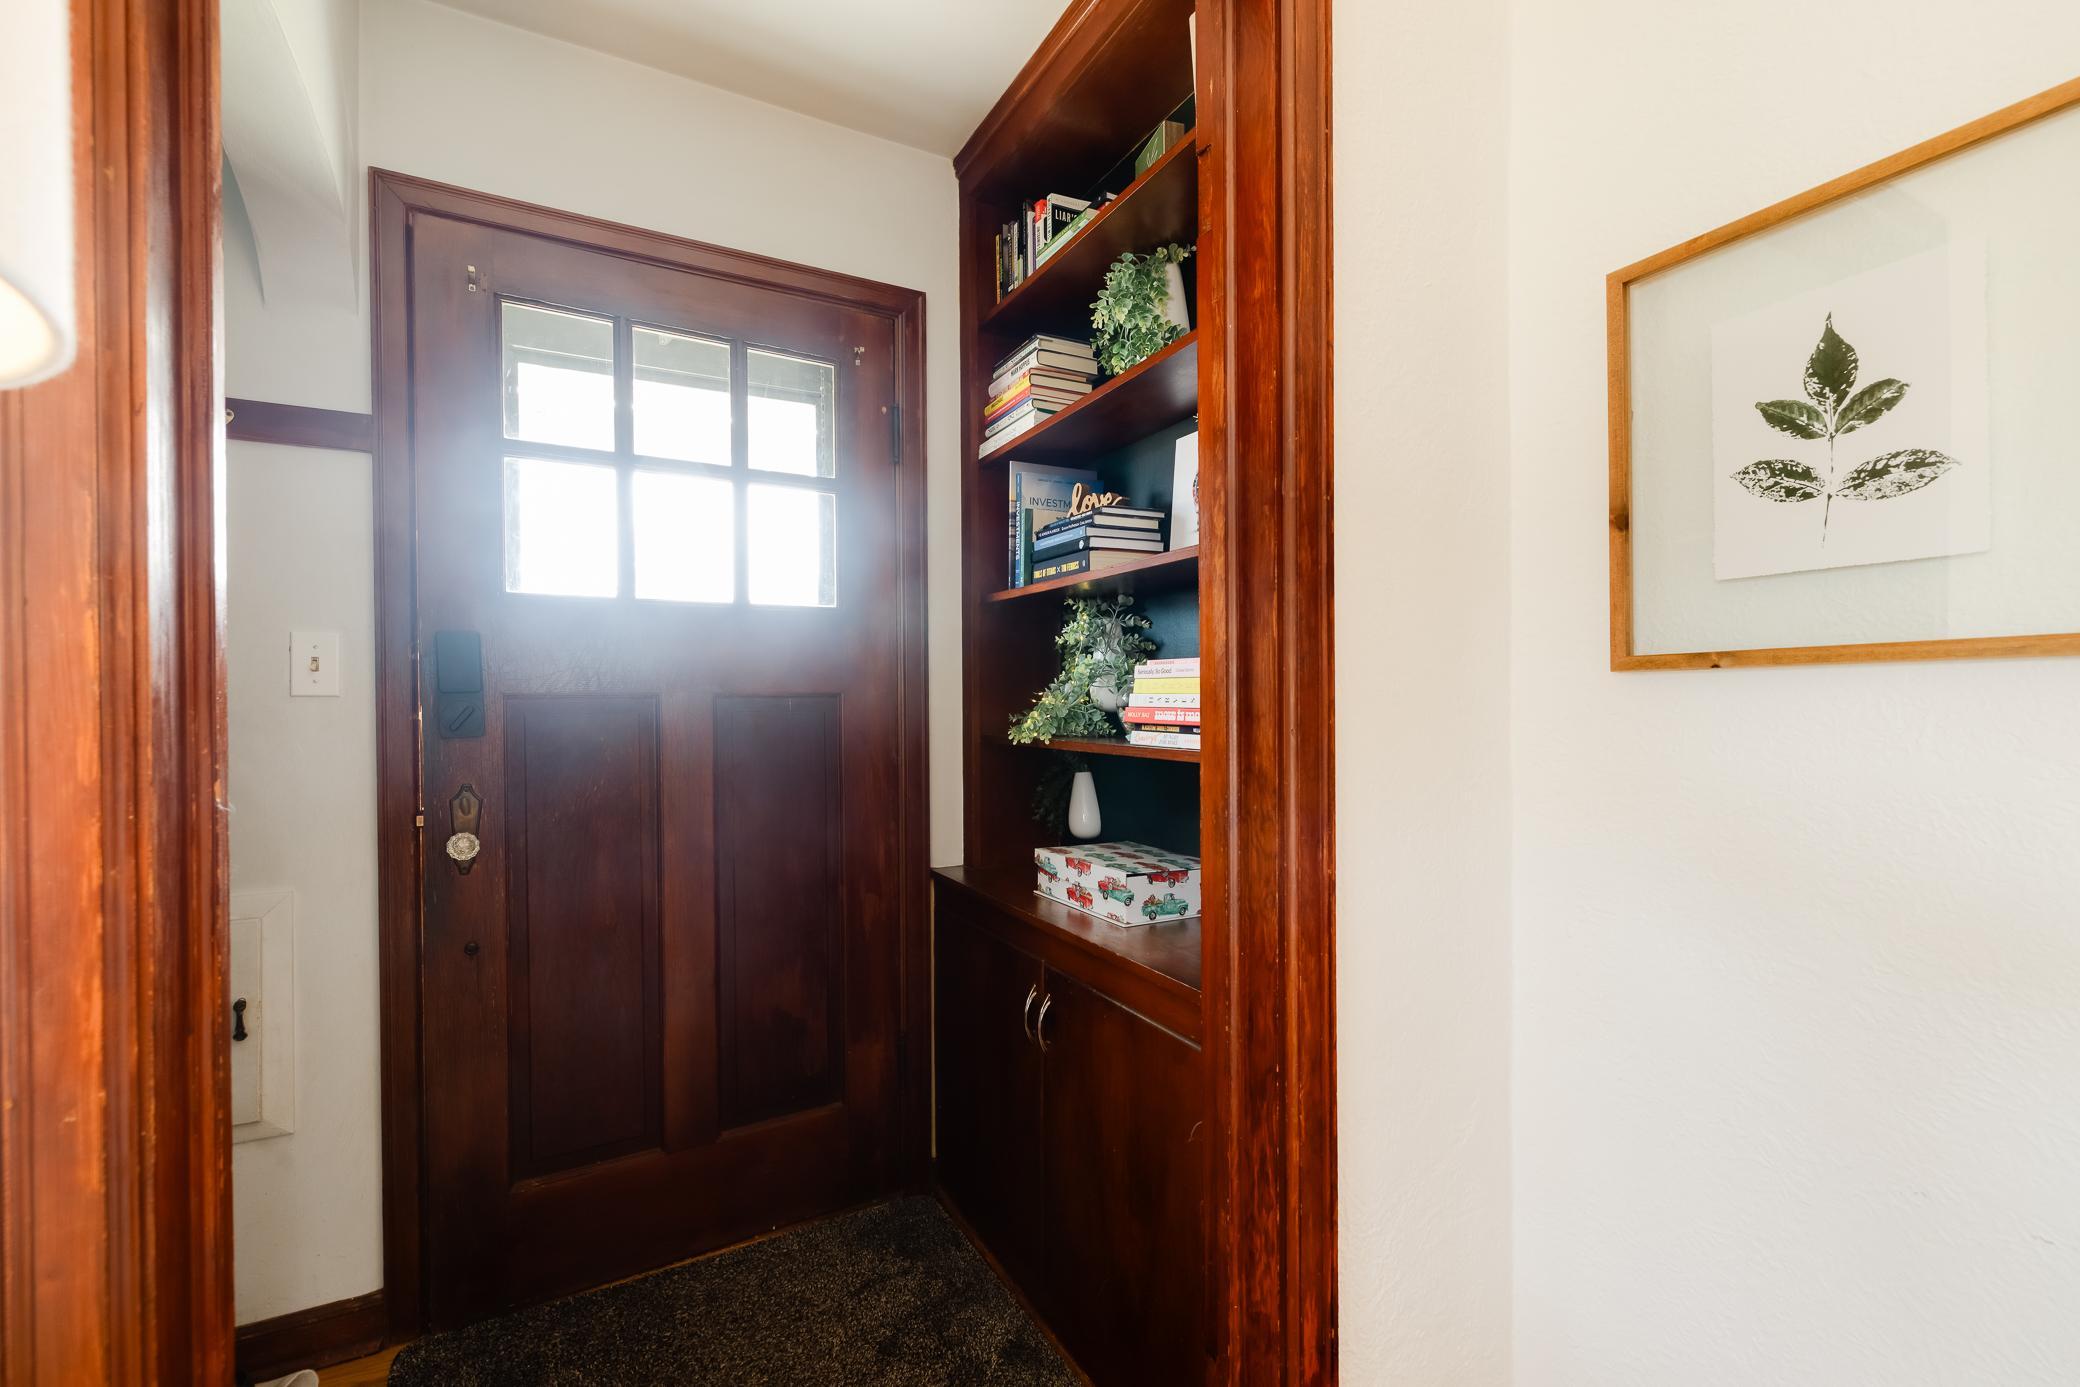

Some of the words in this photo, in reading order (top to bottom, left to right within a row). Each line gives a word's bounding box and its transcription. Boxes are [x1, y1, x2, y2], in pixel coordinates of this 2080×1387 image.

[1029, 497, 1071, 509] INVESTM
[1067, 482, 1122, 517] love
[1185, 711, 1200, 722] mo
